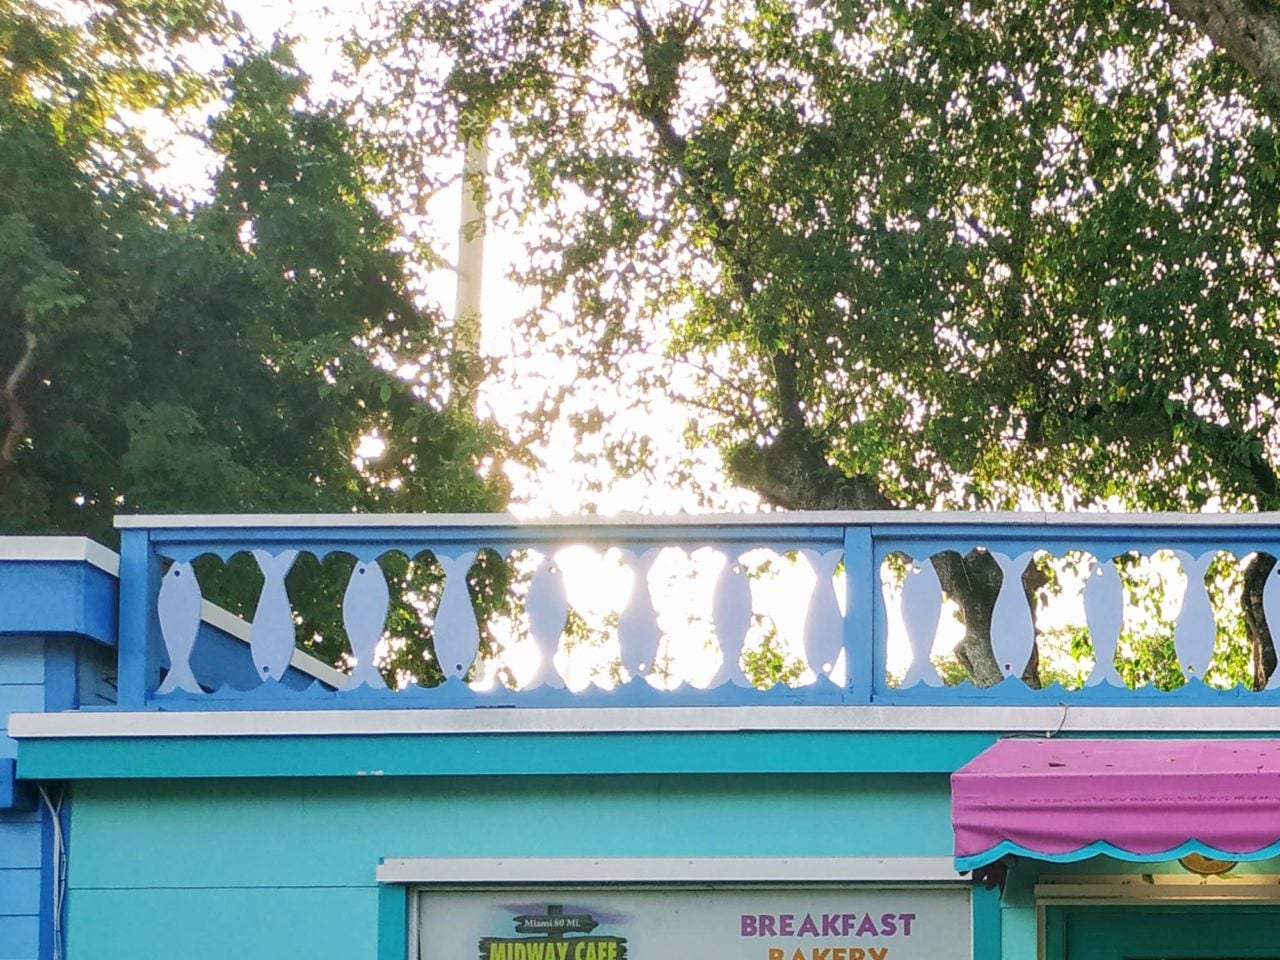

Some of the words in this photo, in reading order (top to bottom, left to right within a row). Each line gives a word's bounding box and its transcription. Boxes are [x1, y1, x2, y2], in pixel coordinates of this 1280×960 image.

[524, 919, 552, 928] Miami
[553, 919, 565, 928] 80
[566, 919, 581, 928] Mi.
[741, 913, 916, 937] BREAKFAST
